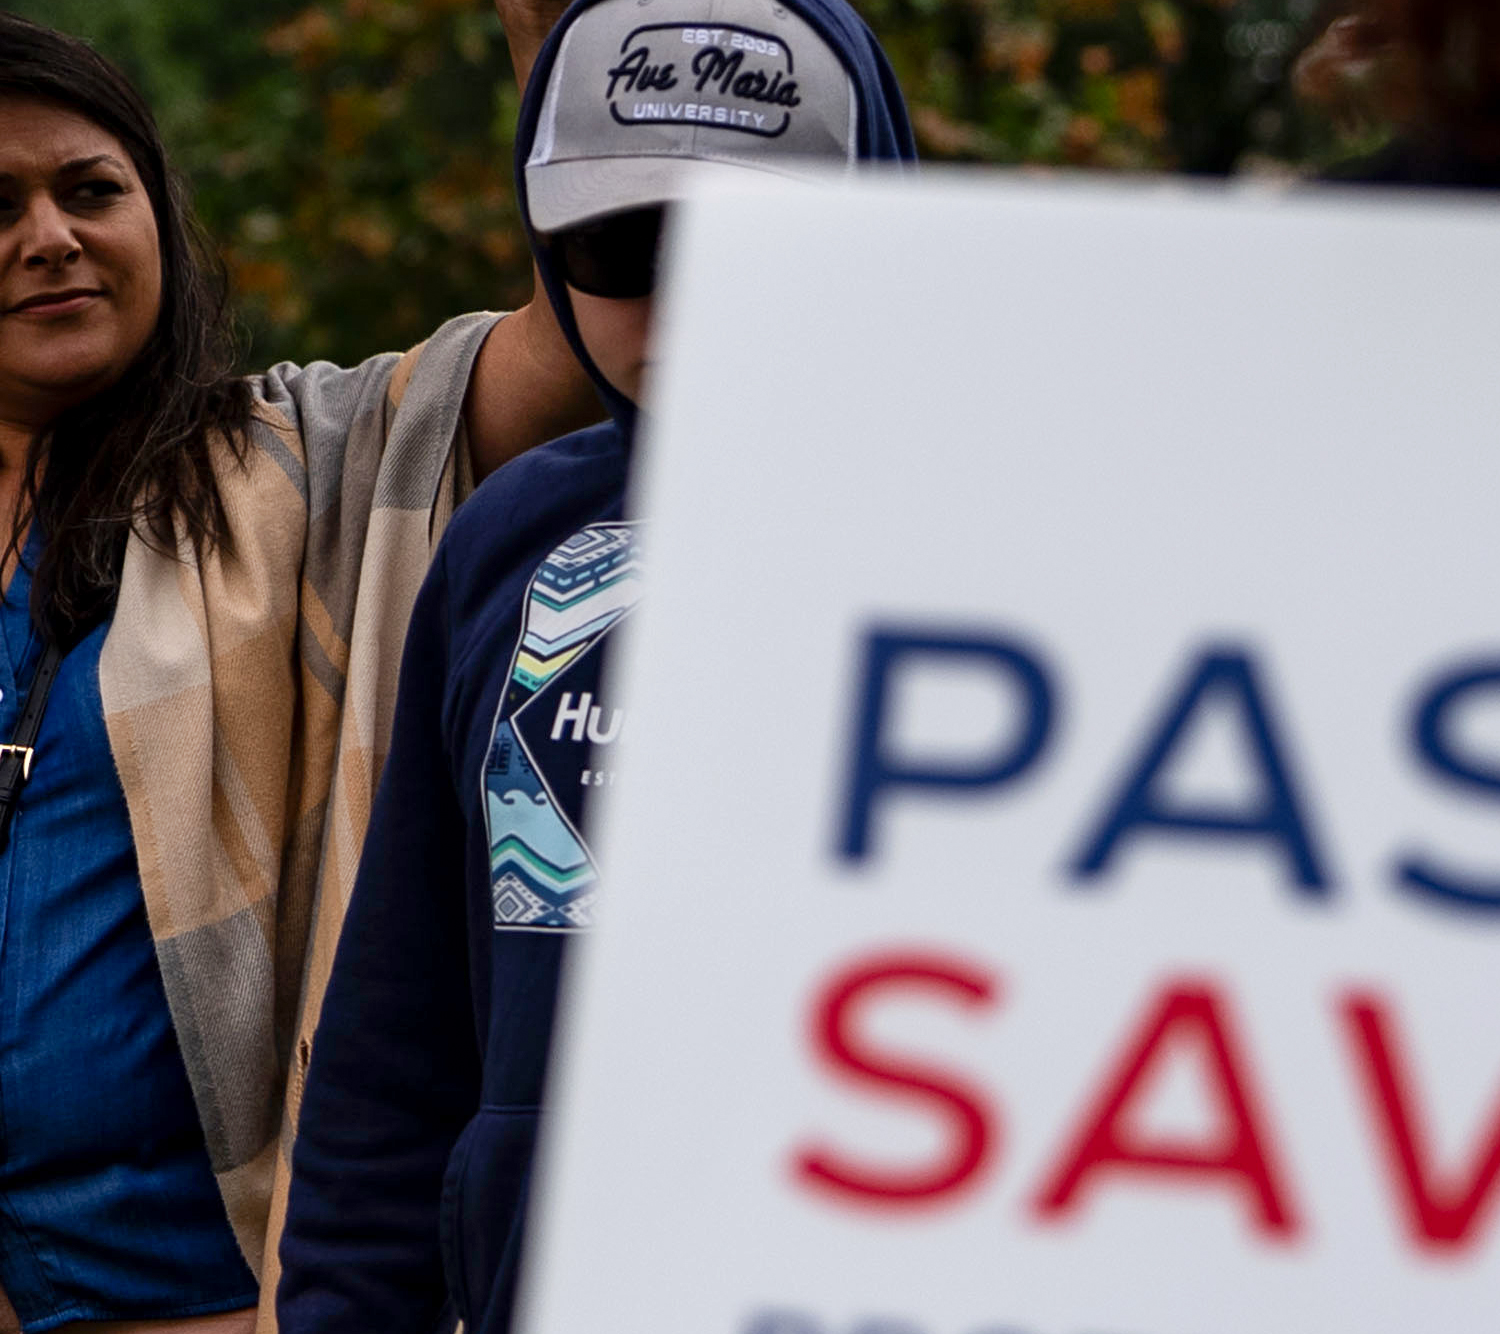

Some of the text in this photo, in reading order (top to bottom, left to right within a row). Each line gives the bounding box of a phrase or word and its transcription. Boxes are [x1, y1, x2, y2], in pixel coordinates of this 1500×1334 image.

[605, 46, 802, 108] Ave Maria
[632, 102, 766, 128] UNIVERSITY
